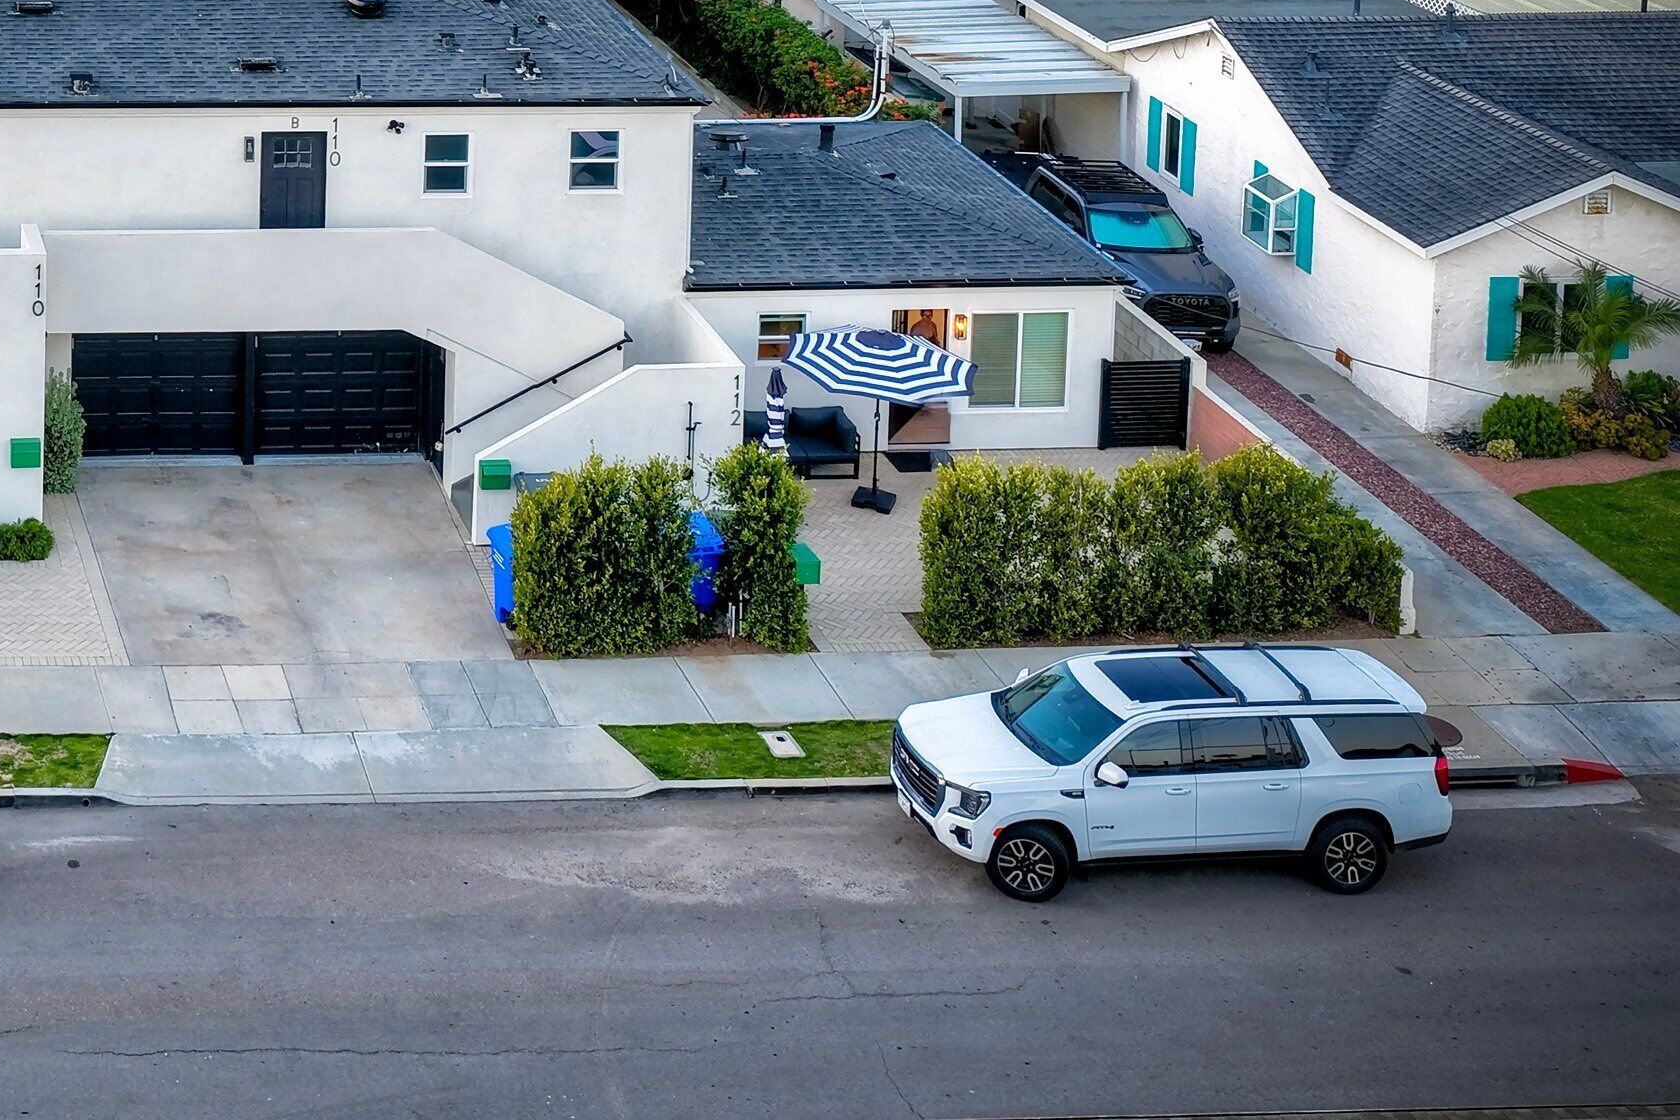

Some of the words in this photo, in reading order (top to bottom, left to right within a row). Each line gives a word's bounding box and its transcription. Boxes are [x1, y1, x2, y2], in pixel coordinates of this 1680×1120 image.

[291, 116, 300, 129] B
[330, 117, 341, 167] 110
[32, 263, 45, 317] 110
[1171, 297, 1211, 307] TOYOTA
[730, 374, 741, 426] 112
